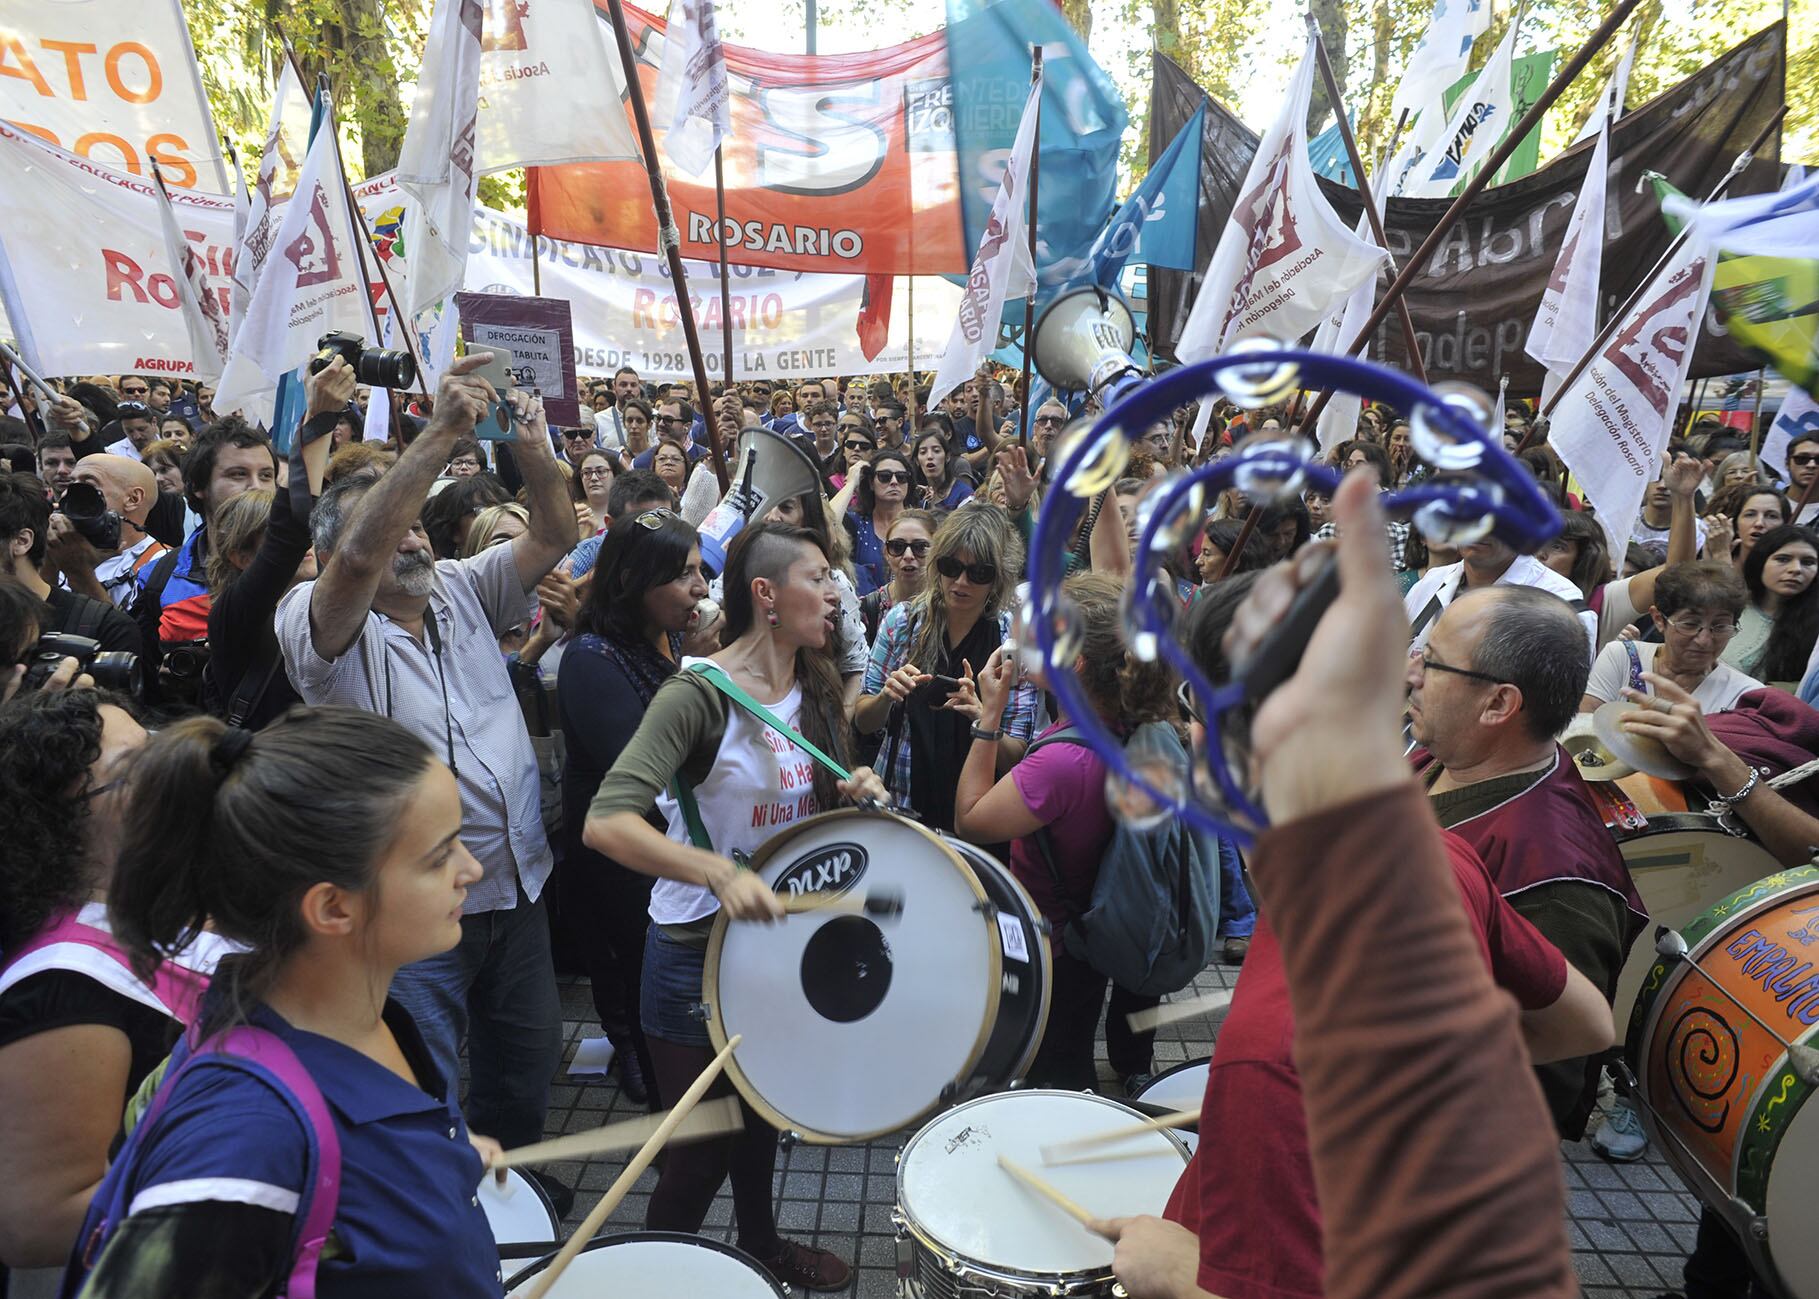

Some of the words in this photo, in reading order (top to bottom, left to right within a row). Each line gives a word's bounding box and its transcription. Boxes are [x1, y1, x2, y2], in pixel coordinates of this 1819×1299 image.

[908, 103, 1022, 138] IZQUIERD
[1428, 158, 1624, 279] Abrl
[688, 210, 864, 260] ROSARIO
[487, 331, 546, 345] DEROGACIÓN
[513, 350, 549, 362] TABLITA
[574, 346, 631, 368] DESDE
[642, 352, 685, 372] 1928
[743, 352, 766, 372] LA
[776, 348, 836, 370] GENTE
[1585, 391, 1622, 441] Delegación
[1617, 440, 1644, 477] Rosario
[1604, 387, 1622, 408] del
[1615, 402, 1652, 457] Magisterio
[779, 766, 793, 791] No
[797, 762, 815, 784] Ha
[751, 803, 768, 828] Ni
[770, 799, 793, 826] Una
